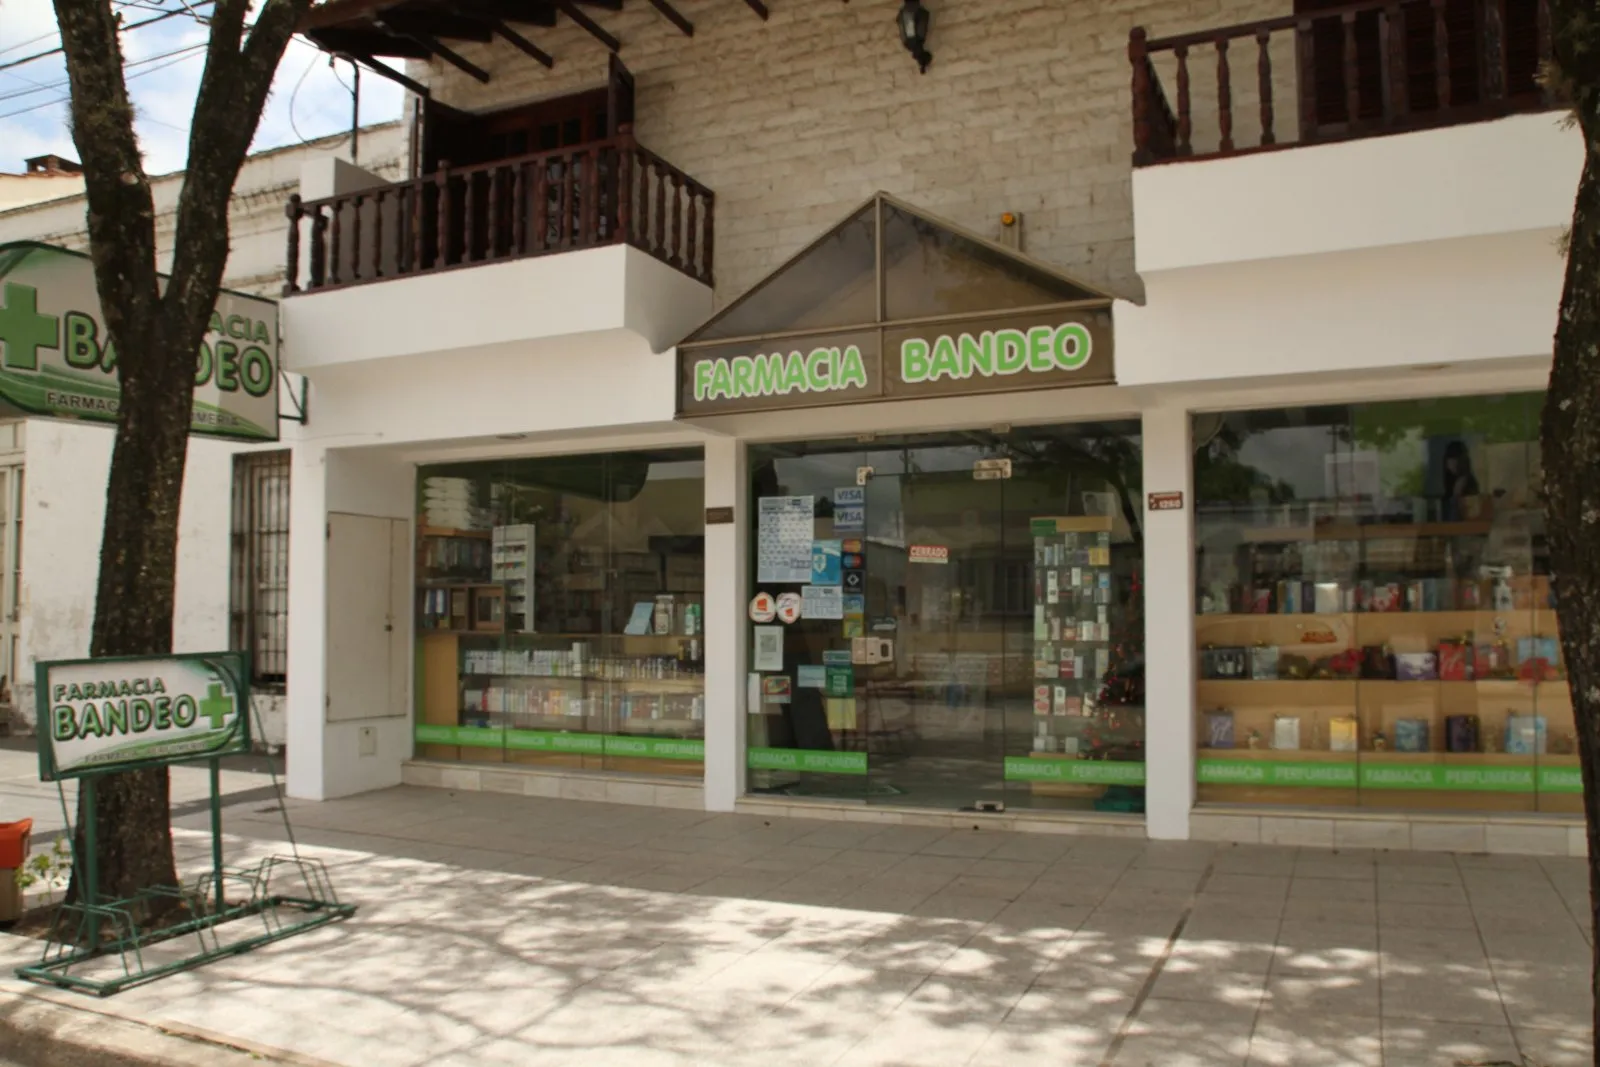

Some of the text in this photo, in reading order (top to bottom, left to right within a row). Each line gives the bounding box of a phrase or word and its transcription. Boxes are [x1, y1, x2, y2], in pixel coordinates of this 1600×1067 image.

[65, 310, 273, 397] BDEO
[694, 321, 1092, 402] FARMACIA BANDEO
[47, 392, 119, 413] FARMAC
[837, 490, 862, 500] VISA
[836, 511, 862, 522] VISA
[910, 546, 948, 557] CERRADO
[53, 677, 166, 702] FARMACIA
[52, 694, 197, 742] BANDEO
